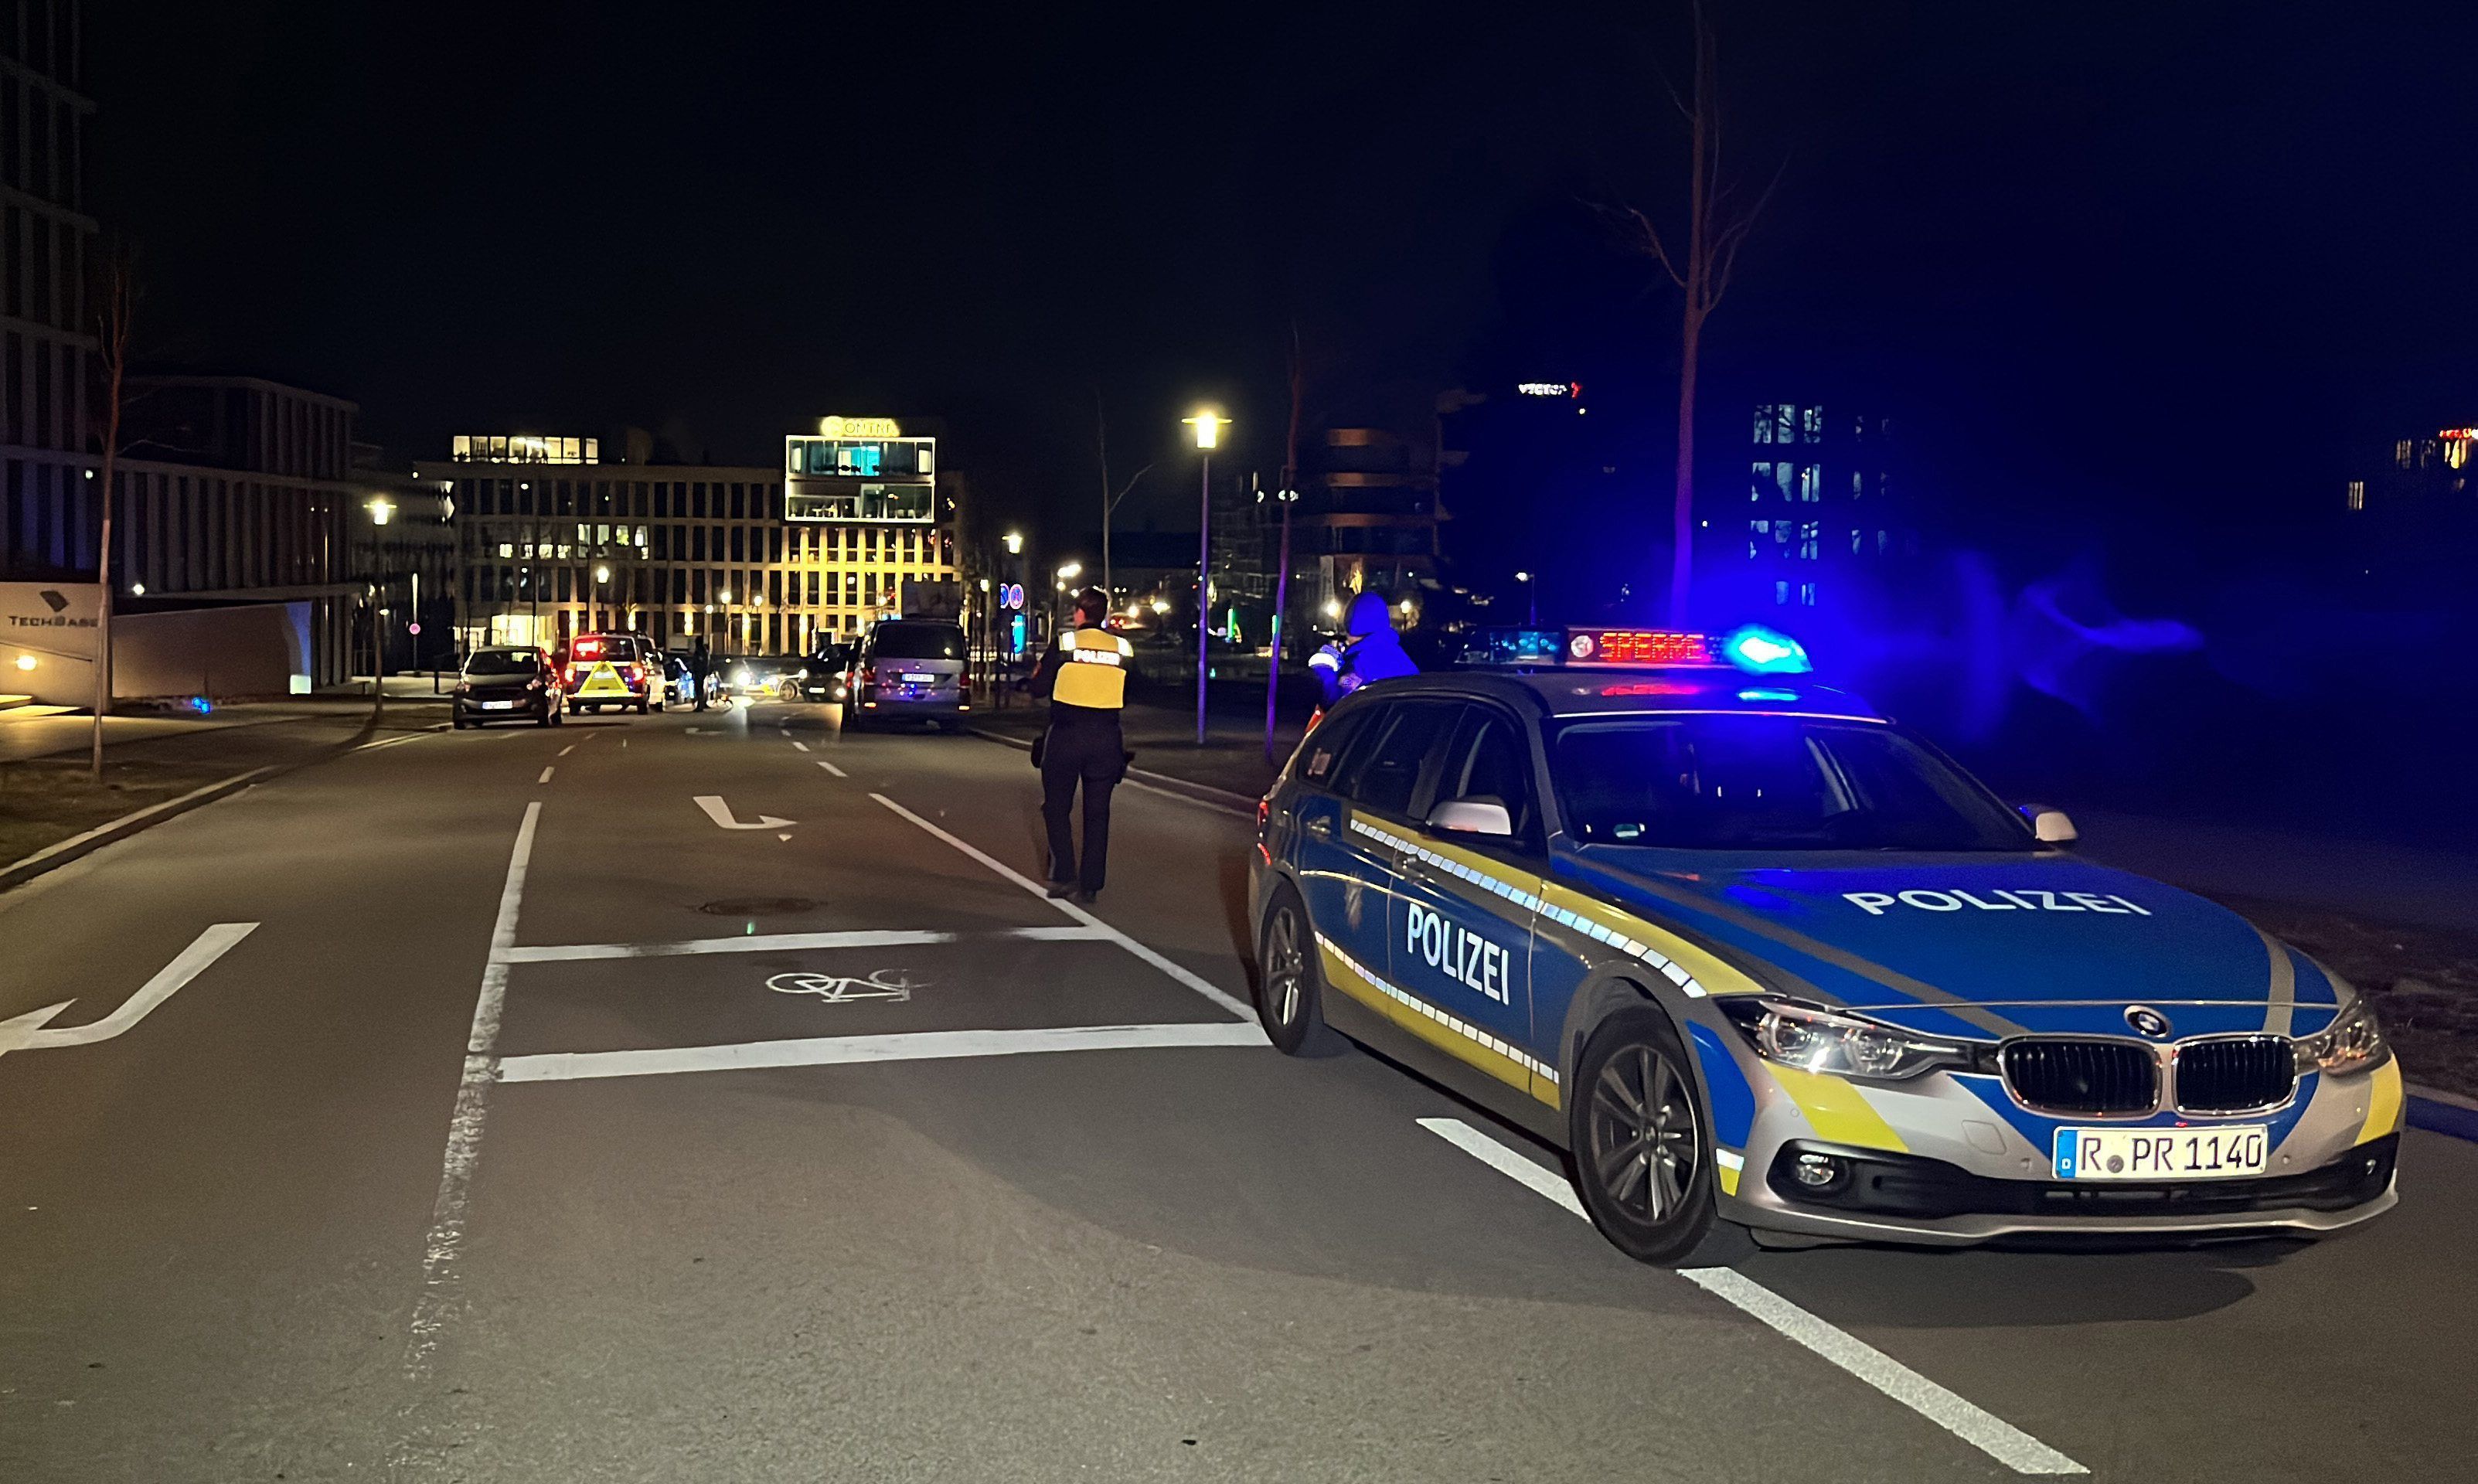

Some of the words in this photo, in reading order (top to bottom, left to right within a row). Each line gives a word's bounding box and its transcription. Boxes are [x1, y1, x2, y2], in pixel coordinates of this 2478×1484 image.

[1074, 649, 1120, 665] POLIZEI
[1599, 632, 1705, 660] SPERRE
[1842, 889, 2152, 916] POLIZEI
[1407, 902, 1510, 1006] POLIZEI
[2081, 1138, 2102, 1171] R
[2132, 1138, 2173, 1172] PR
[2184, 1134, 2261, 1170] 1140
